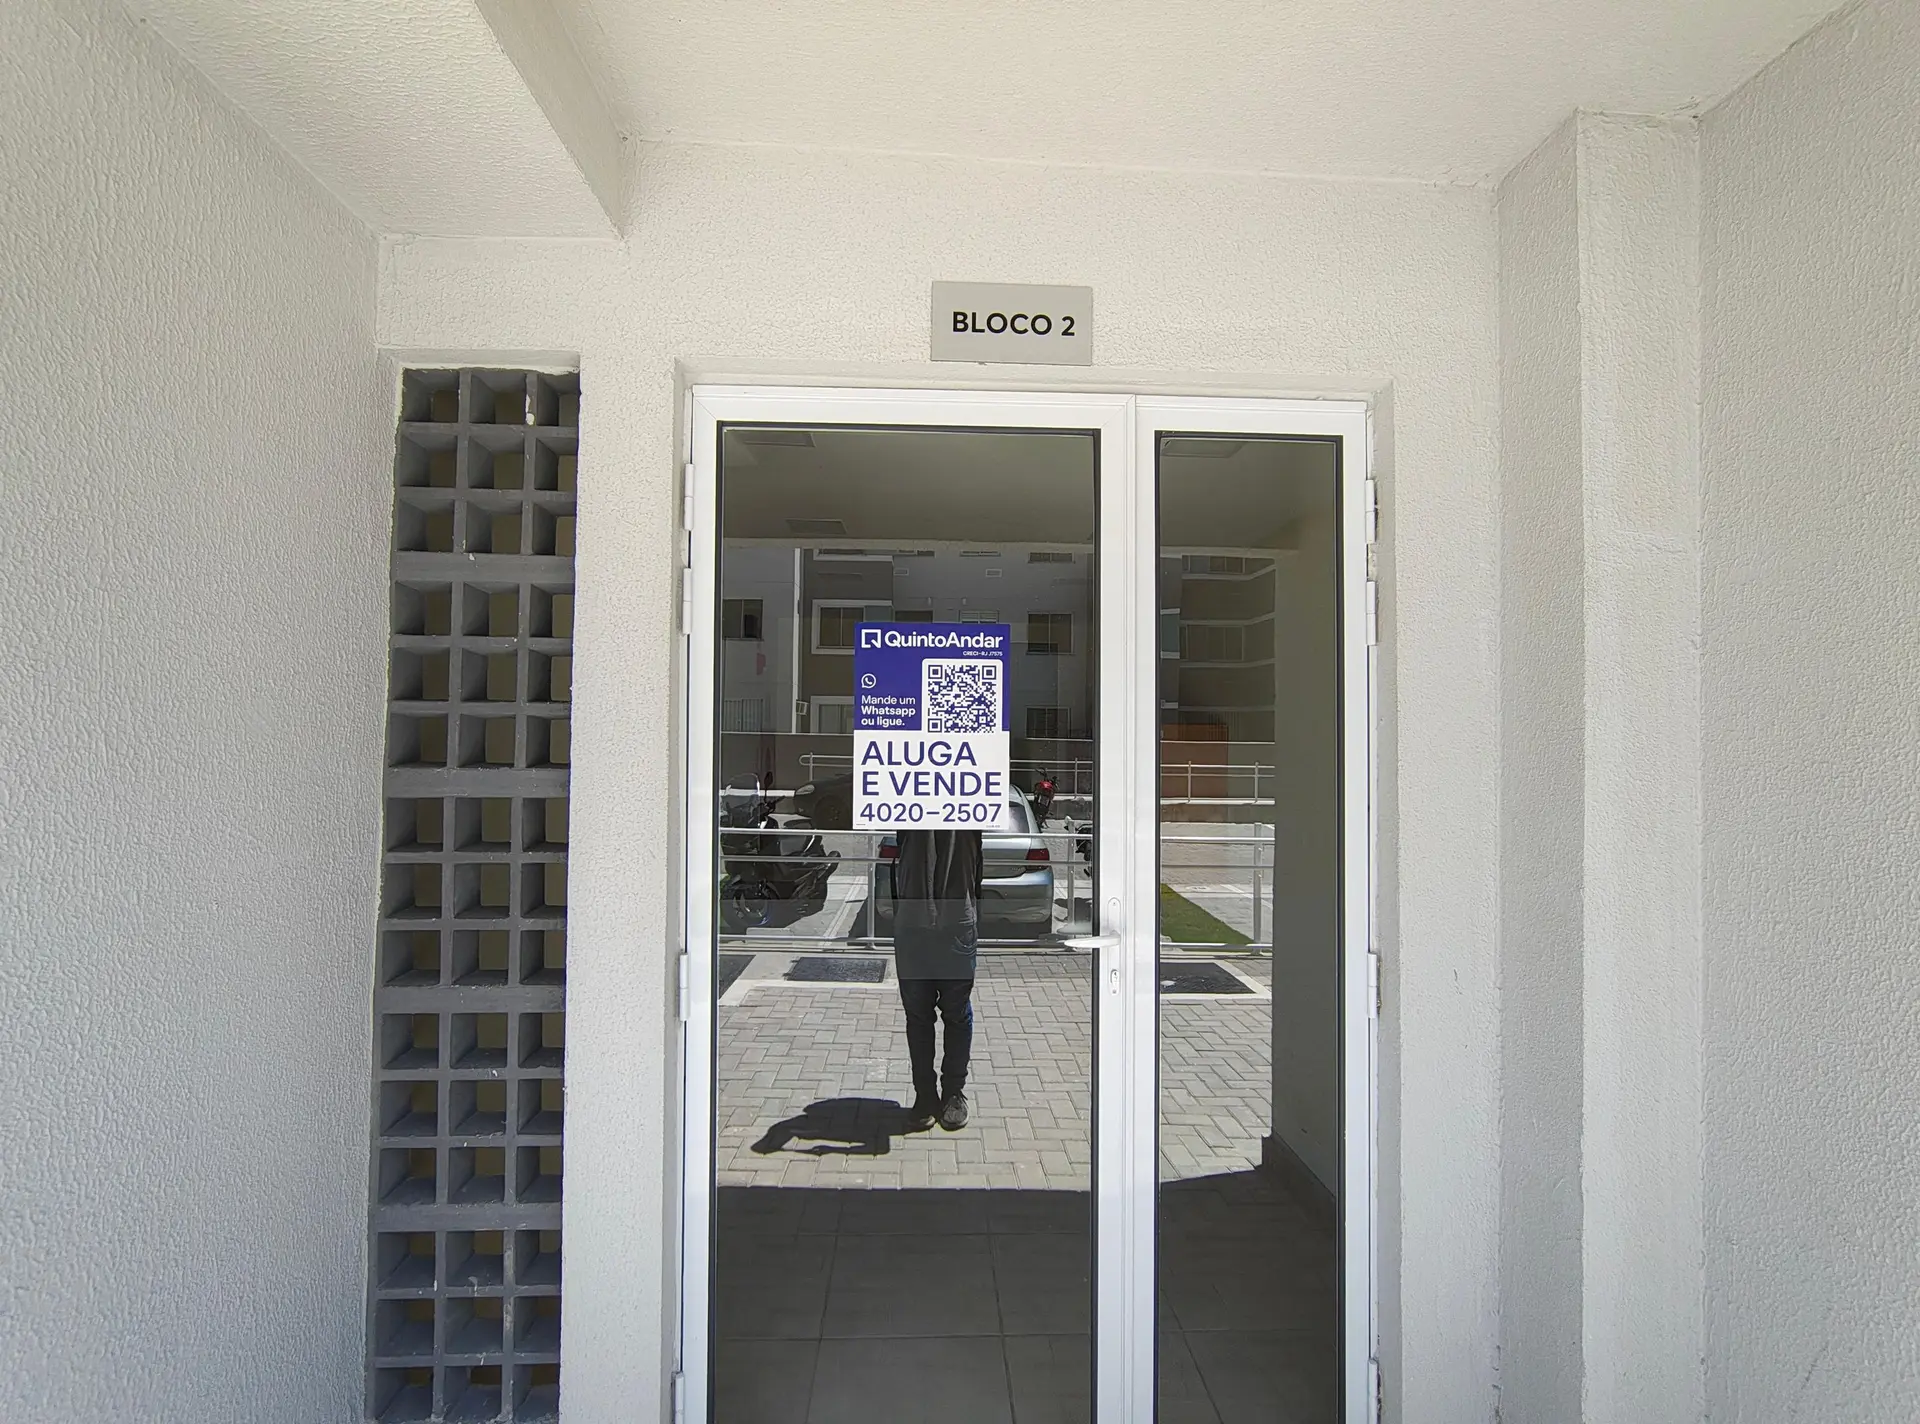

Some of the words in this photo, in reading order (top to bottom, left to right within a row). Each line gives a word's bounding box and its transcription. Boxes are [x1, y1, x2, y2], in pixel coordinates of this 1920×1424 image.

[952, 311, 1052, 336] BLOCO
[1061, 315, 1075, 336] 2
[884, 630, 1003, 648] QuintoAndar
[861, 694, 897, 705] Mande
[899, 697, 916, 705] um
[861, 706, 916, 716] Whatsapp
[877, 716, 905, 727] ligue.
[861, 740, 977, 767] ALUGA
[862, 771, 879, 796] E
[889, 771, 1002, 797] VENDE
[860, 802, 1002, 823] 4020-2507
